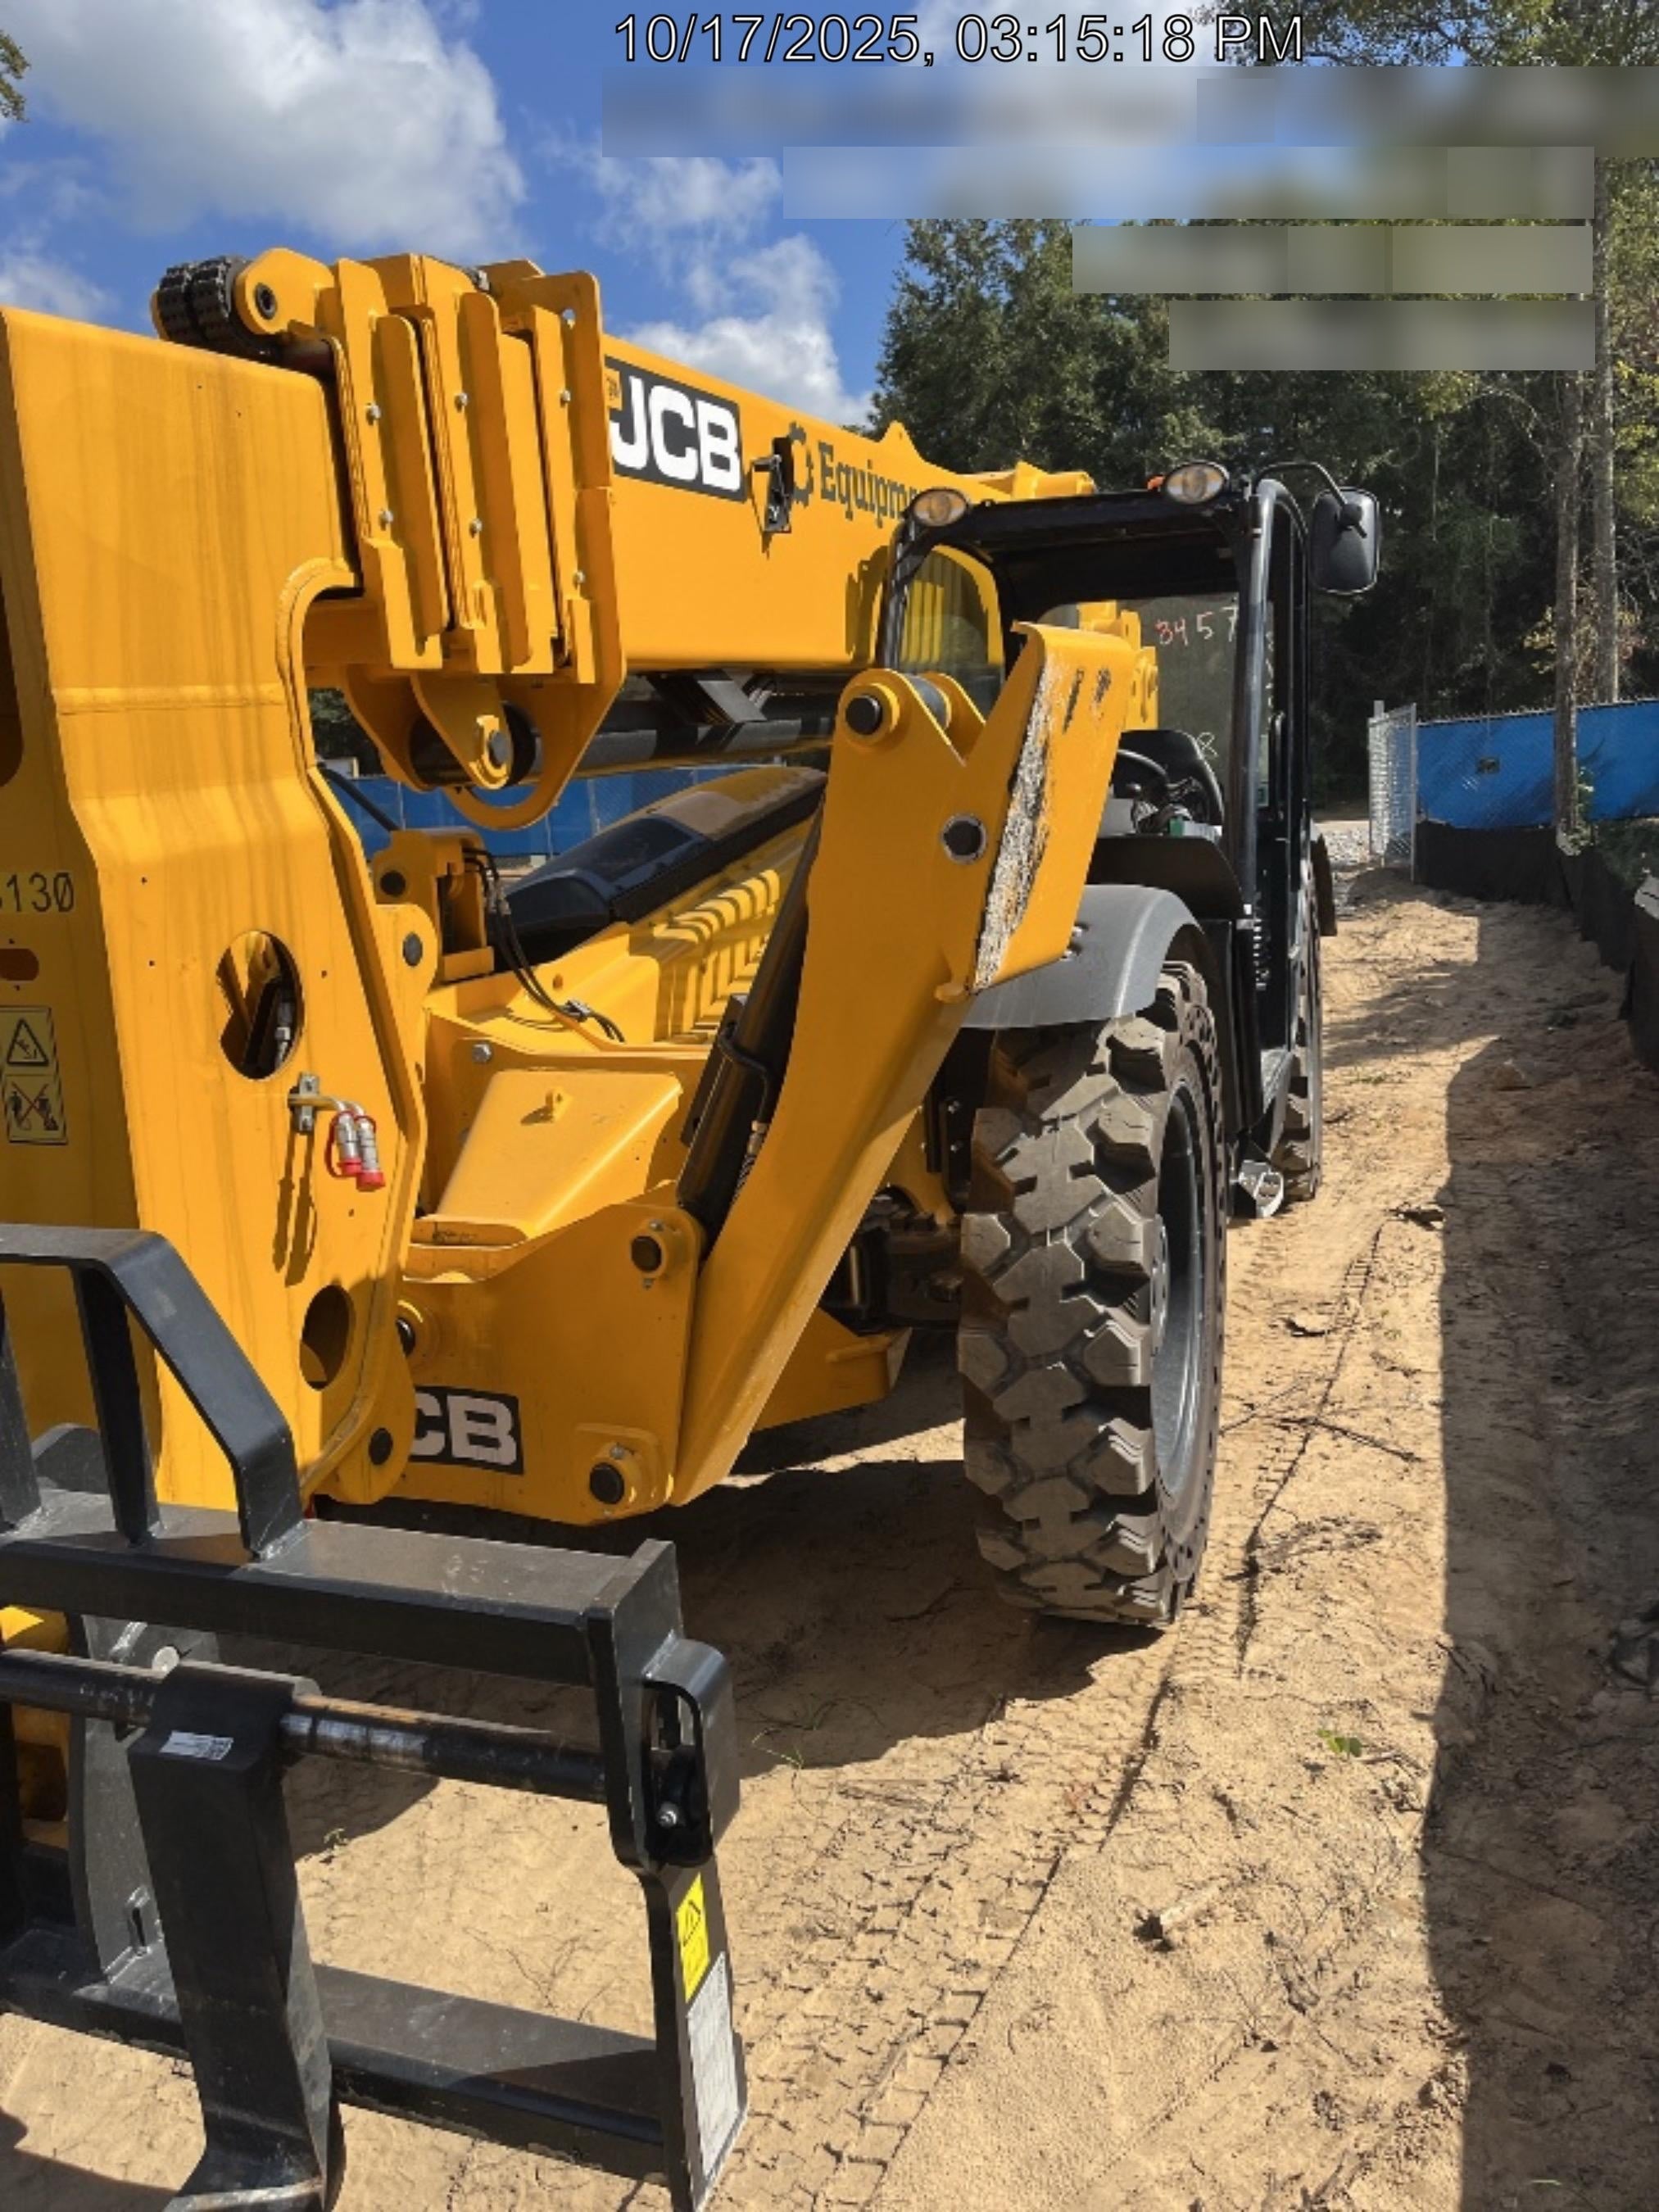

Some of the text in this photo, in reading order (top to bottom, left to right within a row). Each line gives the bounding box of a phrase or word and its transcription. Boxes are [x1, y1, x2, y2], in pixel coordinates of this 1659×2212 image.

[609, 374, 742, 492] JCB
[0, 871, 75, 913] 130
[408, 1392, 518, 1466] CB
